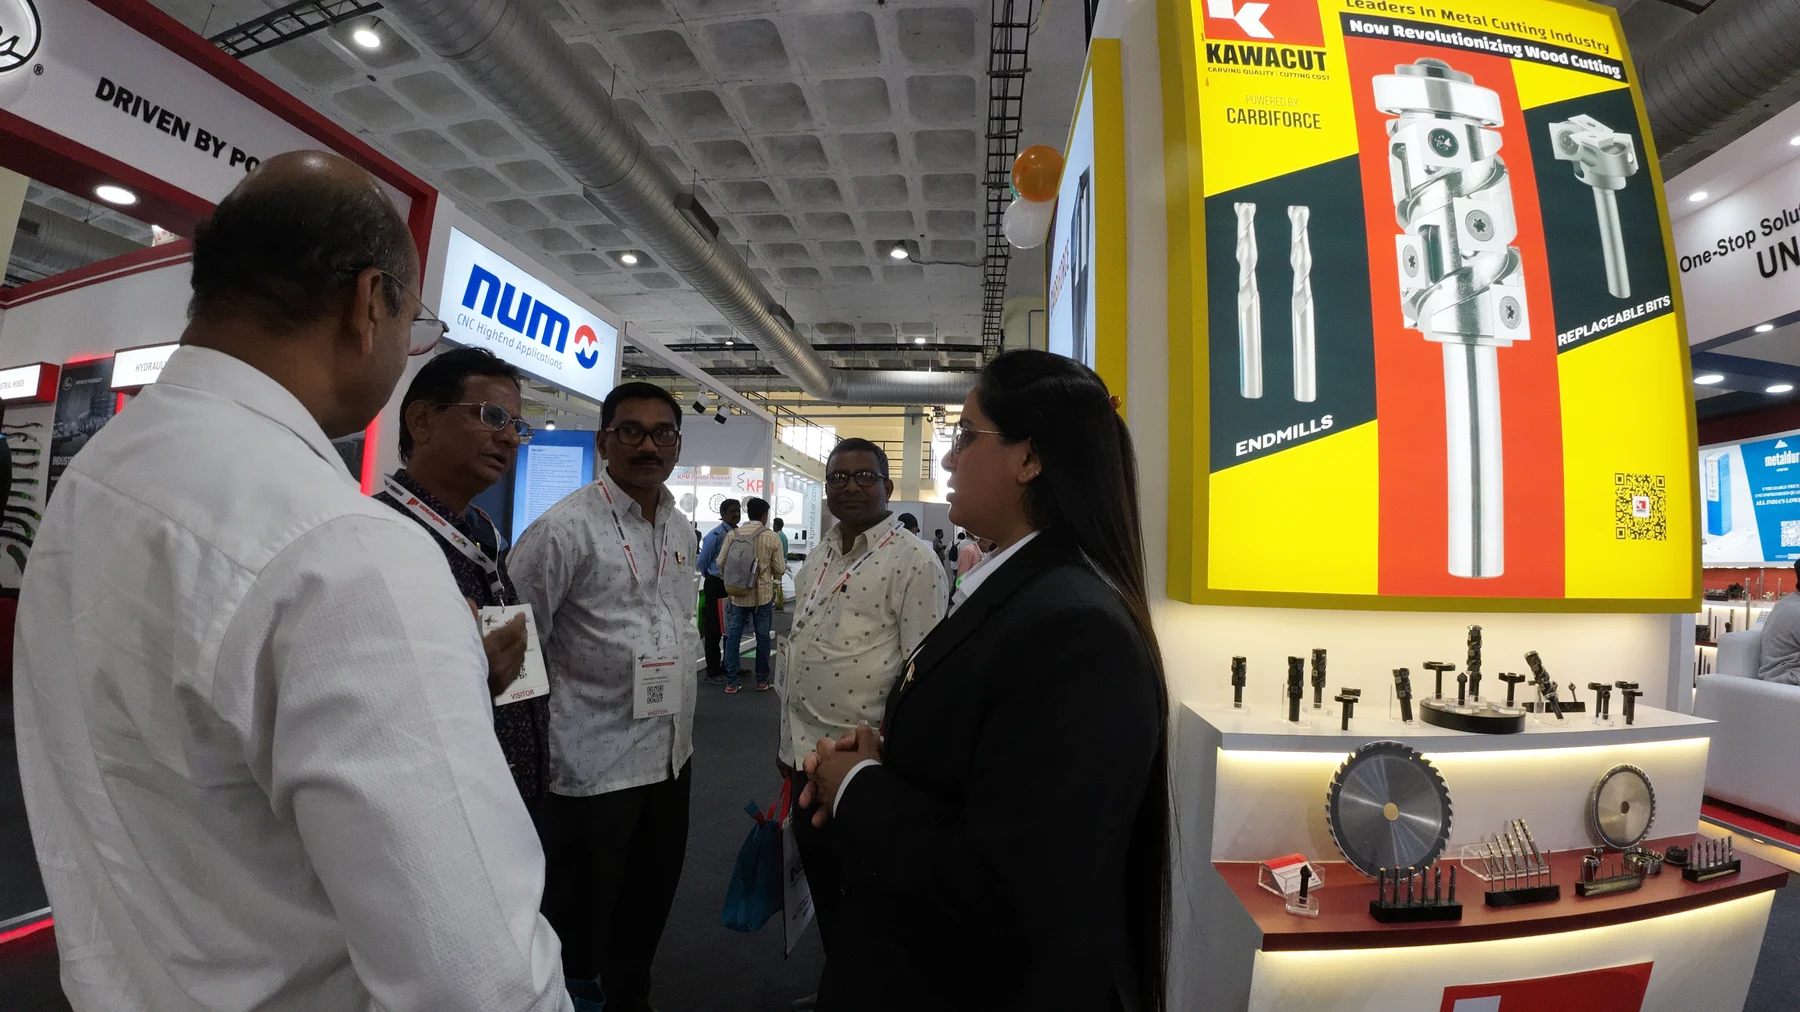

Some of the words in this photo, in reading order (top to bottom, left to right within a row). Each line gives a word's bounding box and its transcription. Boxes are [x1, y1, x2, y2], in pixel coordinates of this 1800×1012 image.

[1346, 0, 1415, 15] Leaders
[1420, 5, 1436, 17] In
[1441, 10, 1488, 27] Metal
[1491, 18, 1547, 39] Cutting
[1550, 28, 1610, 54] Industry
[1206, 42, 1327, 72] KAWACUT
[1349, 19, 1390, 36] Now
[1392, 24, 1524, 58] Revolutionizing
[1524, 44, 1569, 66] Wood
[1570, 54, 1622, 80] Cutting
[1207, 66, 1242, 75] CARVING
[1243, 69, 1274, 77] QUALITY
[1279, 71, 1311, 79] CUTTING
[1312, 73, 1330, 81] COST
[95, 76, 191, 142] DRIVEN
[194, 128, 227, 159] BY
[1226, 107, 1322, 130] CARBIFORCE
[1245, 94, 1286, 107] POWERED
[1287, 97, 1299, 107] BY
[1679, 229, 1756, 273] One-Stop
[1759, 202, 1800, 237] Solu
[461, 263, 571, 355] num
[1557, 304, 1645, 347] REPLACEABLE
[1645, 295, 1671, 314] BITS
[456, 313, 476, 331] CNC
[476, 321, 515, 349] HighEnd
[516, 340, 563, 371] Applications
[1235, 414, 1334, 457] ENDMILLS
[1765, 451, 1800, 466] metaldur
[510, 688, 535, 700] VISITOR
[647, 708, 669, 717] VISITOR
